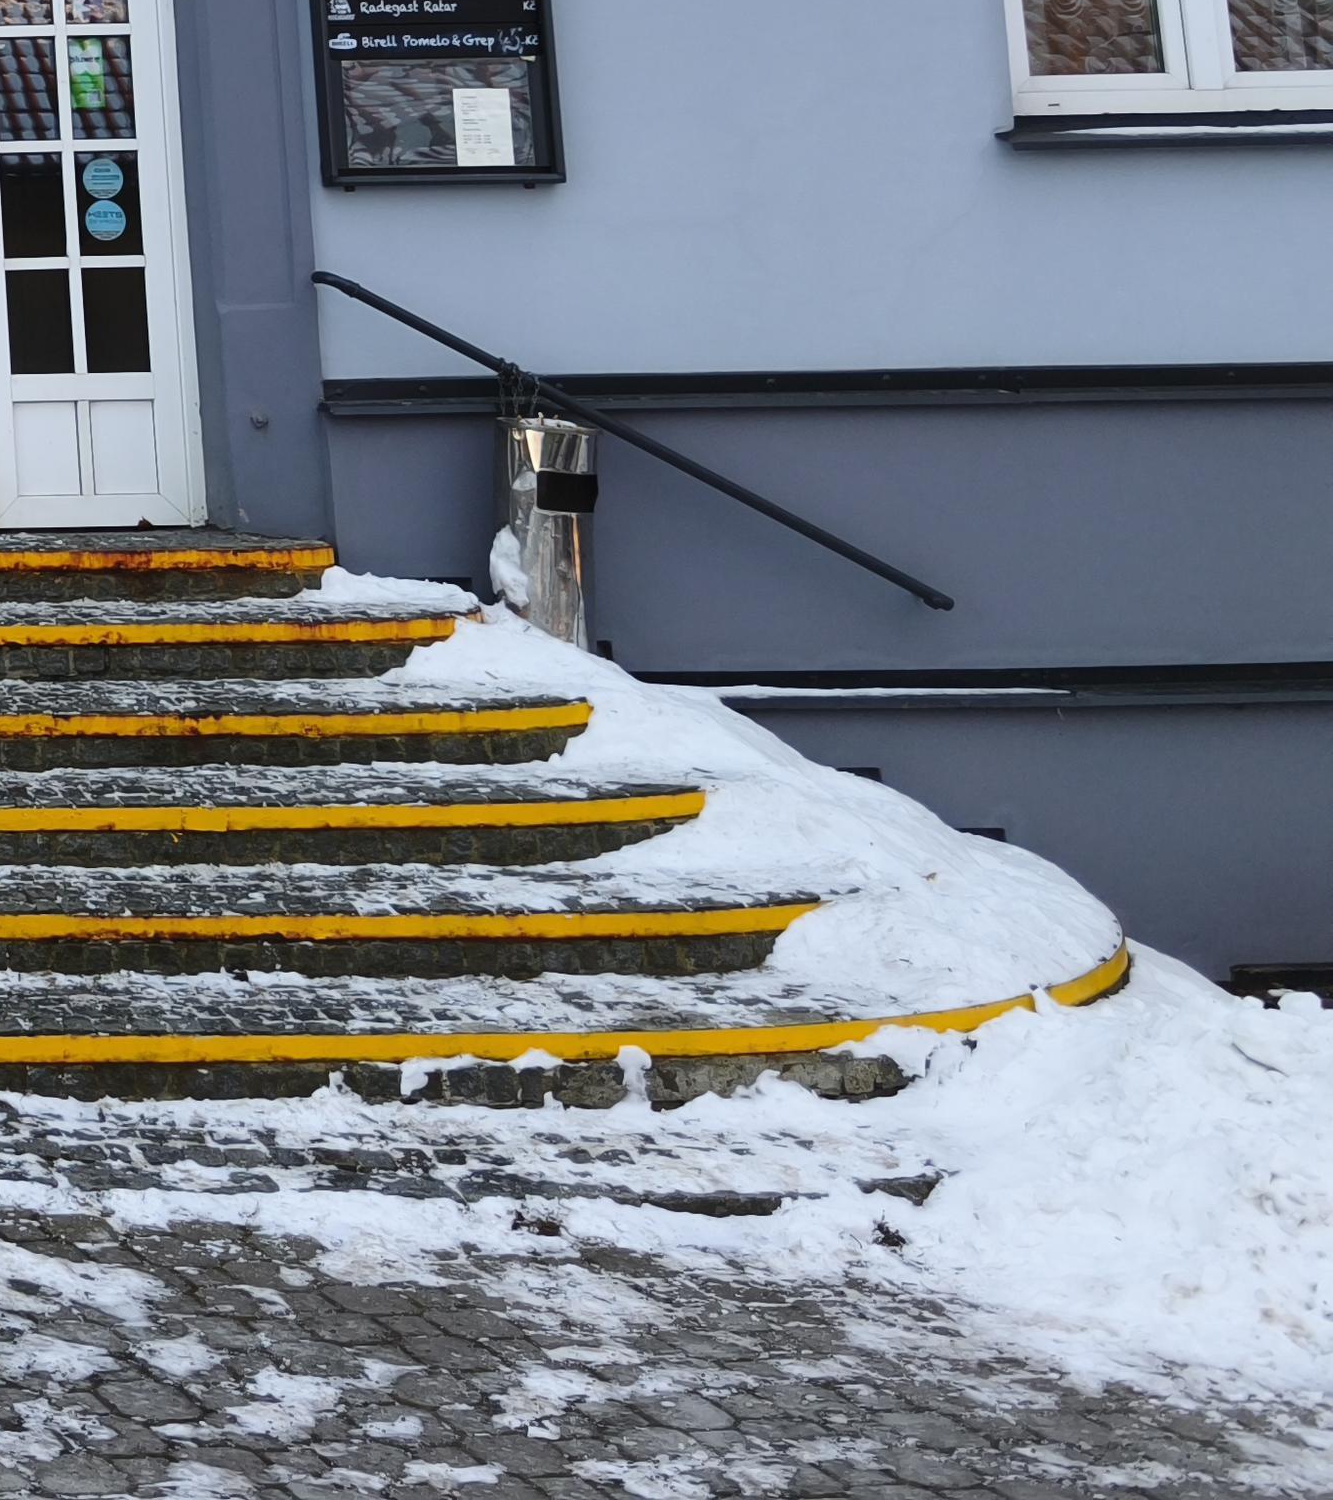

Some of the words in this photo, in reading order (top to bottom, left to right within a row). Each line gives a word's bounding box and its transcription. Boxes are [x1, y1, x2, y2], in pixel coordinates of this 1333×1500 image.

[359, 0, 419, 17] Radegast
[423, 1, 458, 13] Ratar
[523, 0, 537, 11] Kč
[361, 35, 397, 47] Birell
[402, 34, 450, 47] Pomelo
[452, 34, 460, 46] &
[462, 34, 494, 52] Grep
[525, 34, 539, 46] Kč
